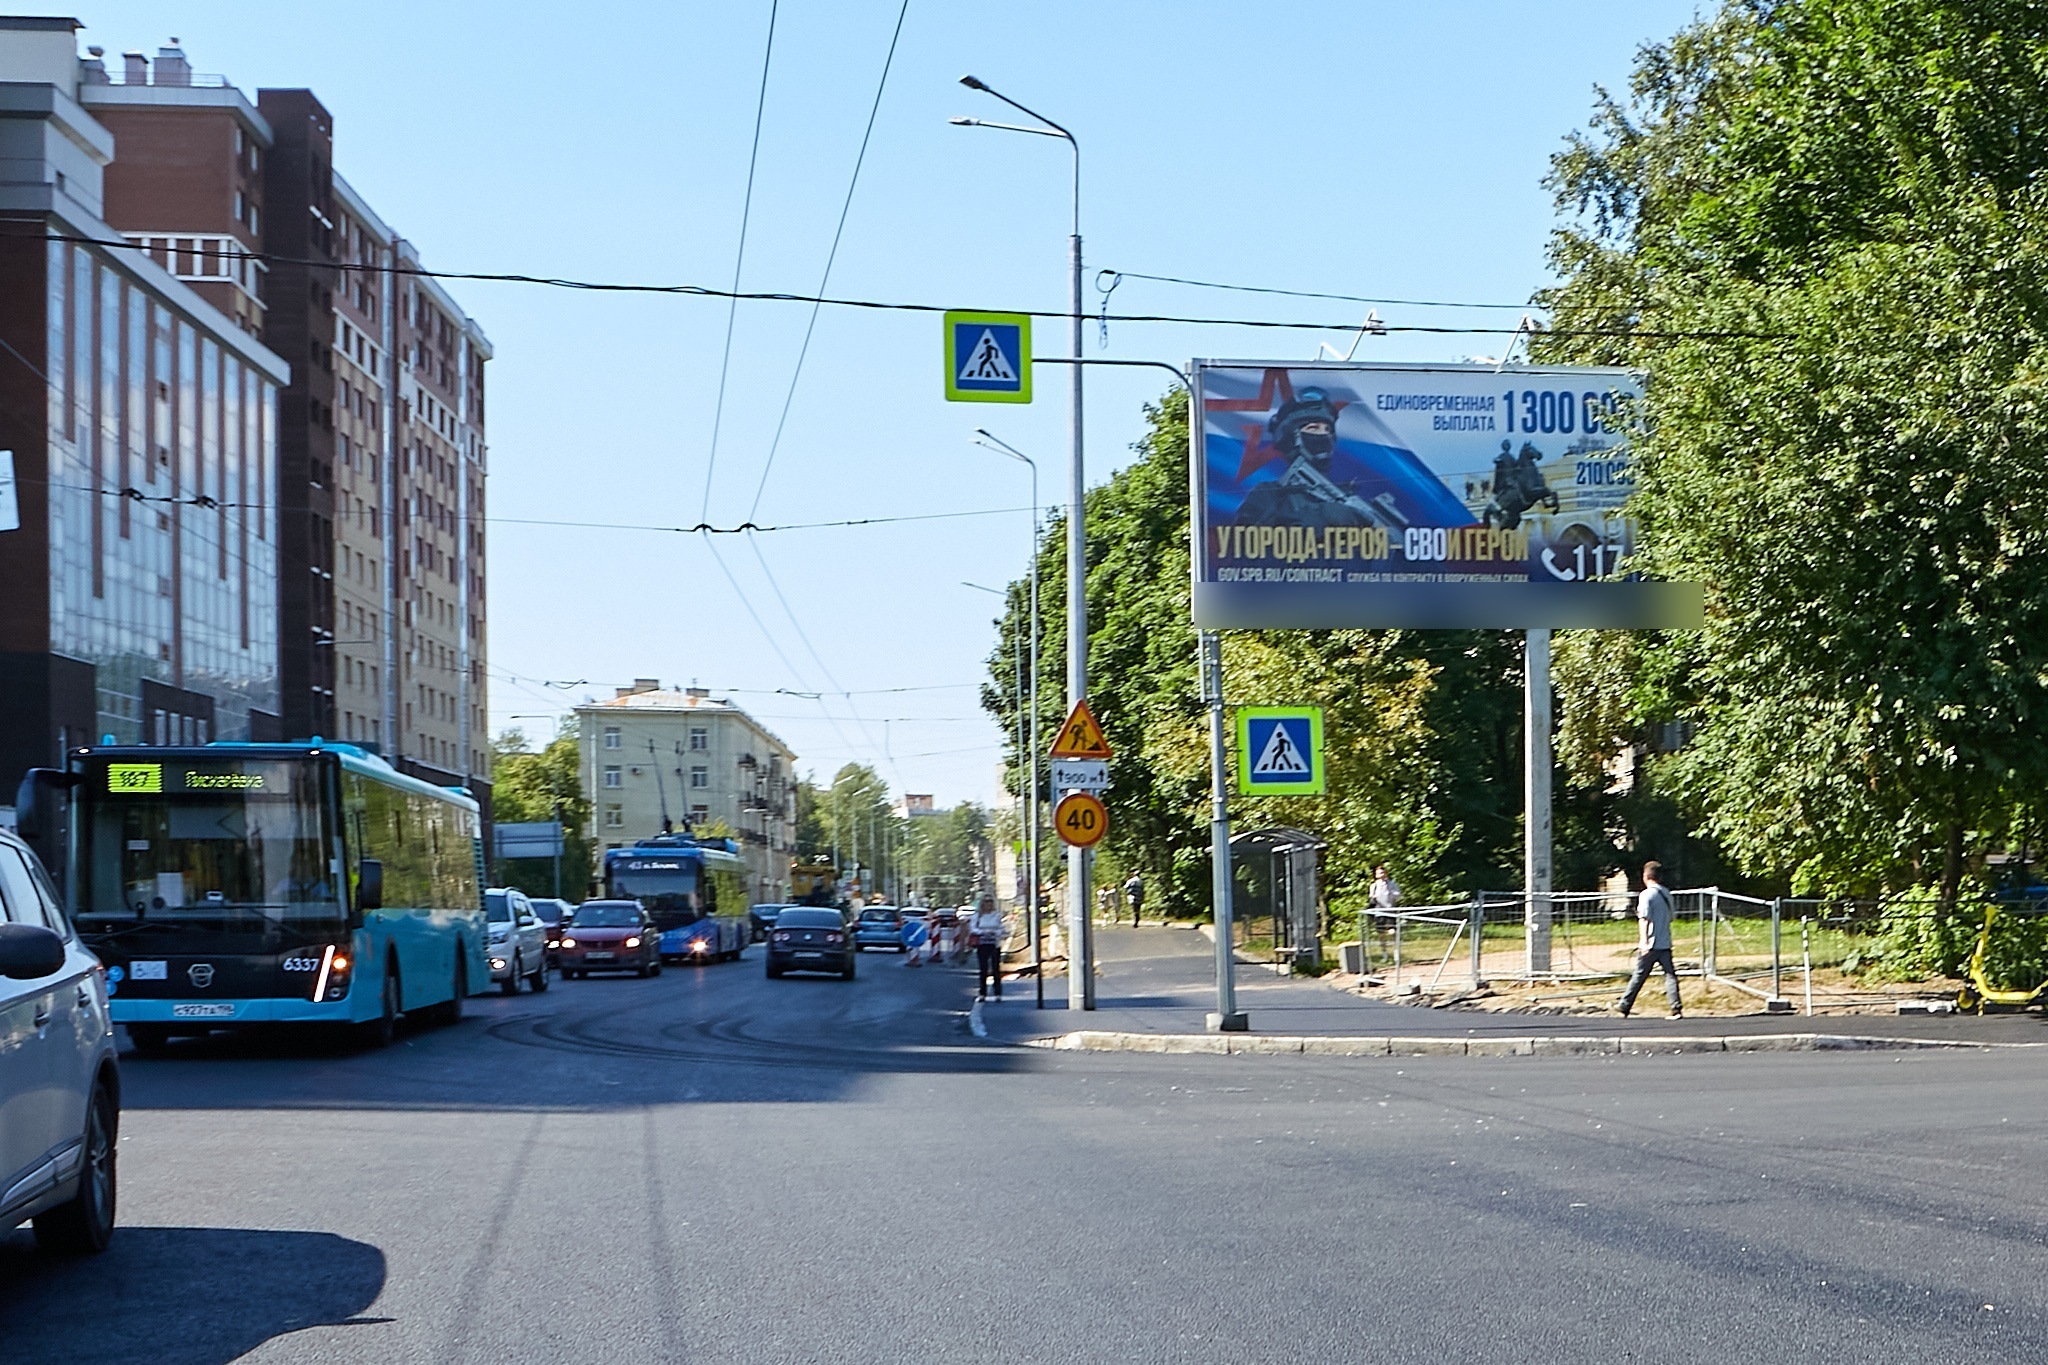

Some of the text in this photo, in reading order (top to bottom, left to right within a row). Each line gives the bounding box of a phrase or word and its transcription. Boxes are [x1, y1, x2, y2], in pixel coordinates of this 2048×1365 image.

[1377, 394, 1495, 412] ЕДИНОВРЕМЕННАЯ
[1433, 415, 1496, 432] ВЫПЛАТА
[1572, 544, 1625, 580] 117
[1217, 567, 1343, 582] GOV.SPB.RU/CONTRACT
[1064, 773, 1087, 784] 900
[1066, 809, 1096, 830] 40
[283, 957, 320, 972] 6337
